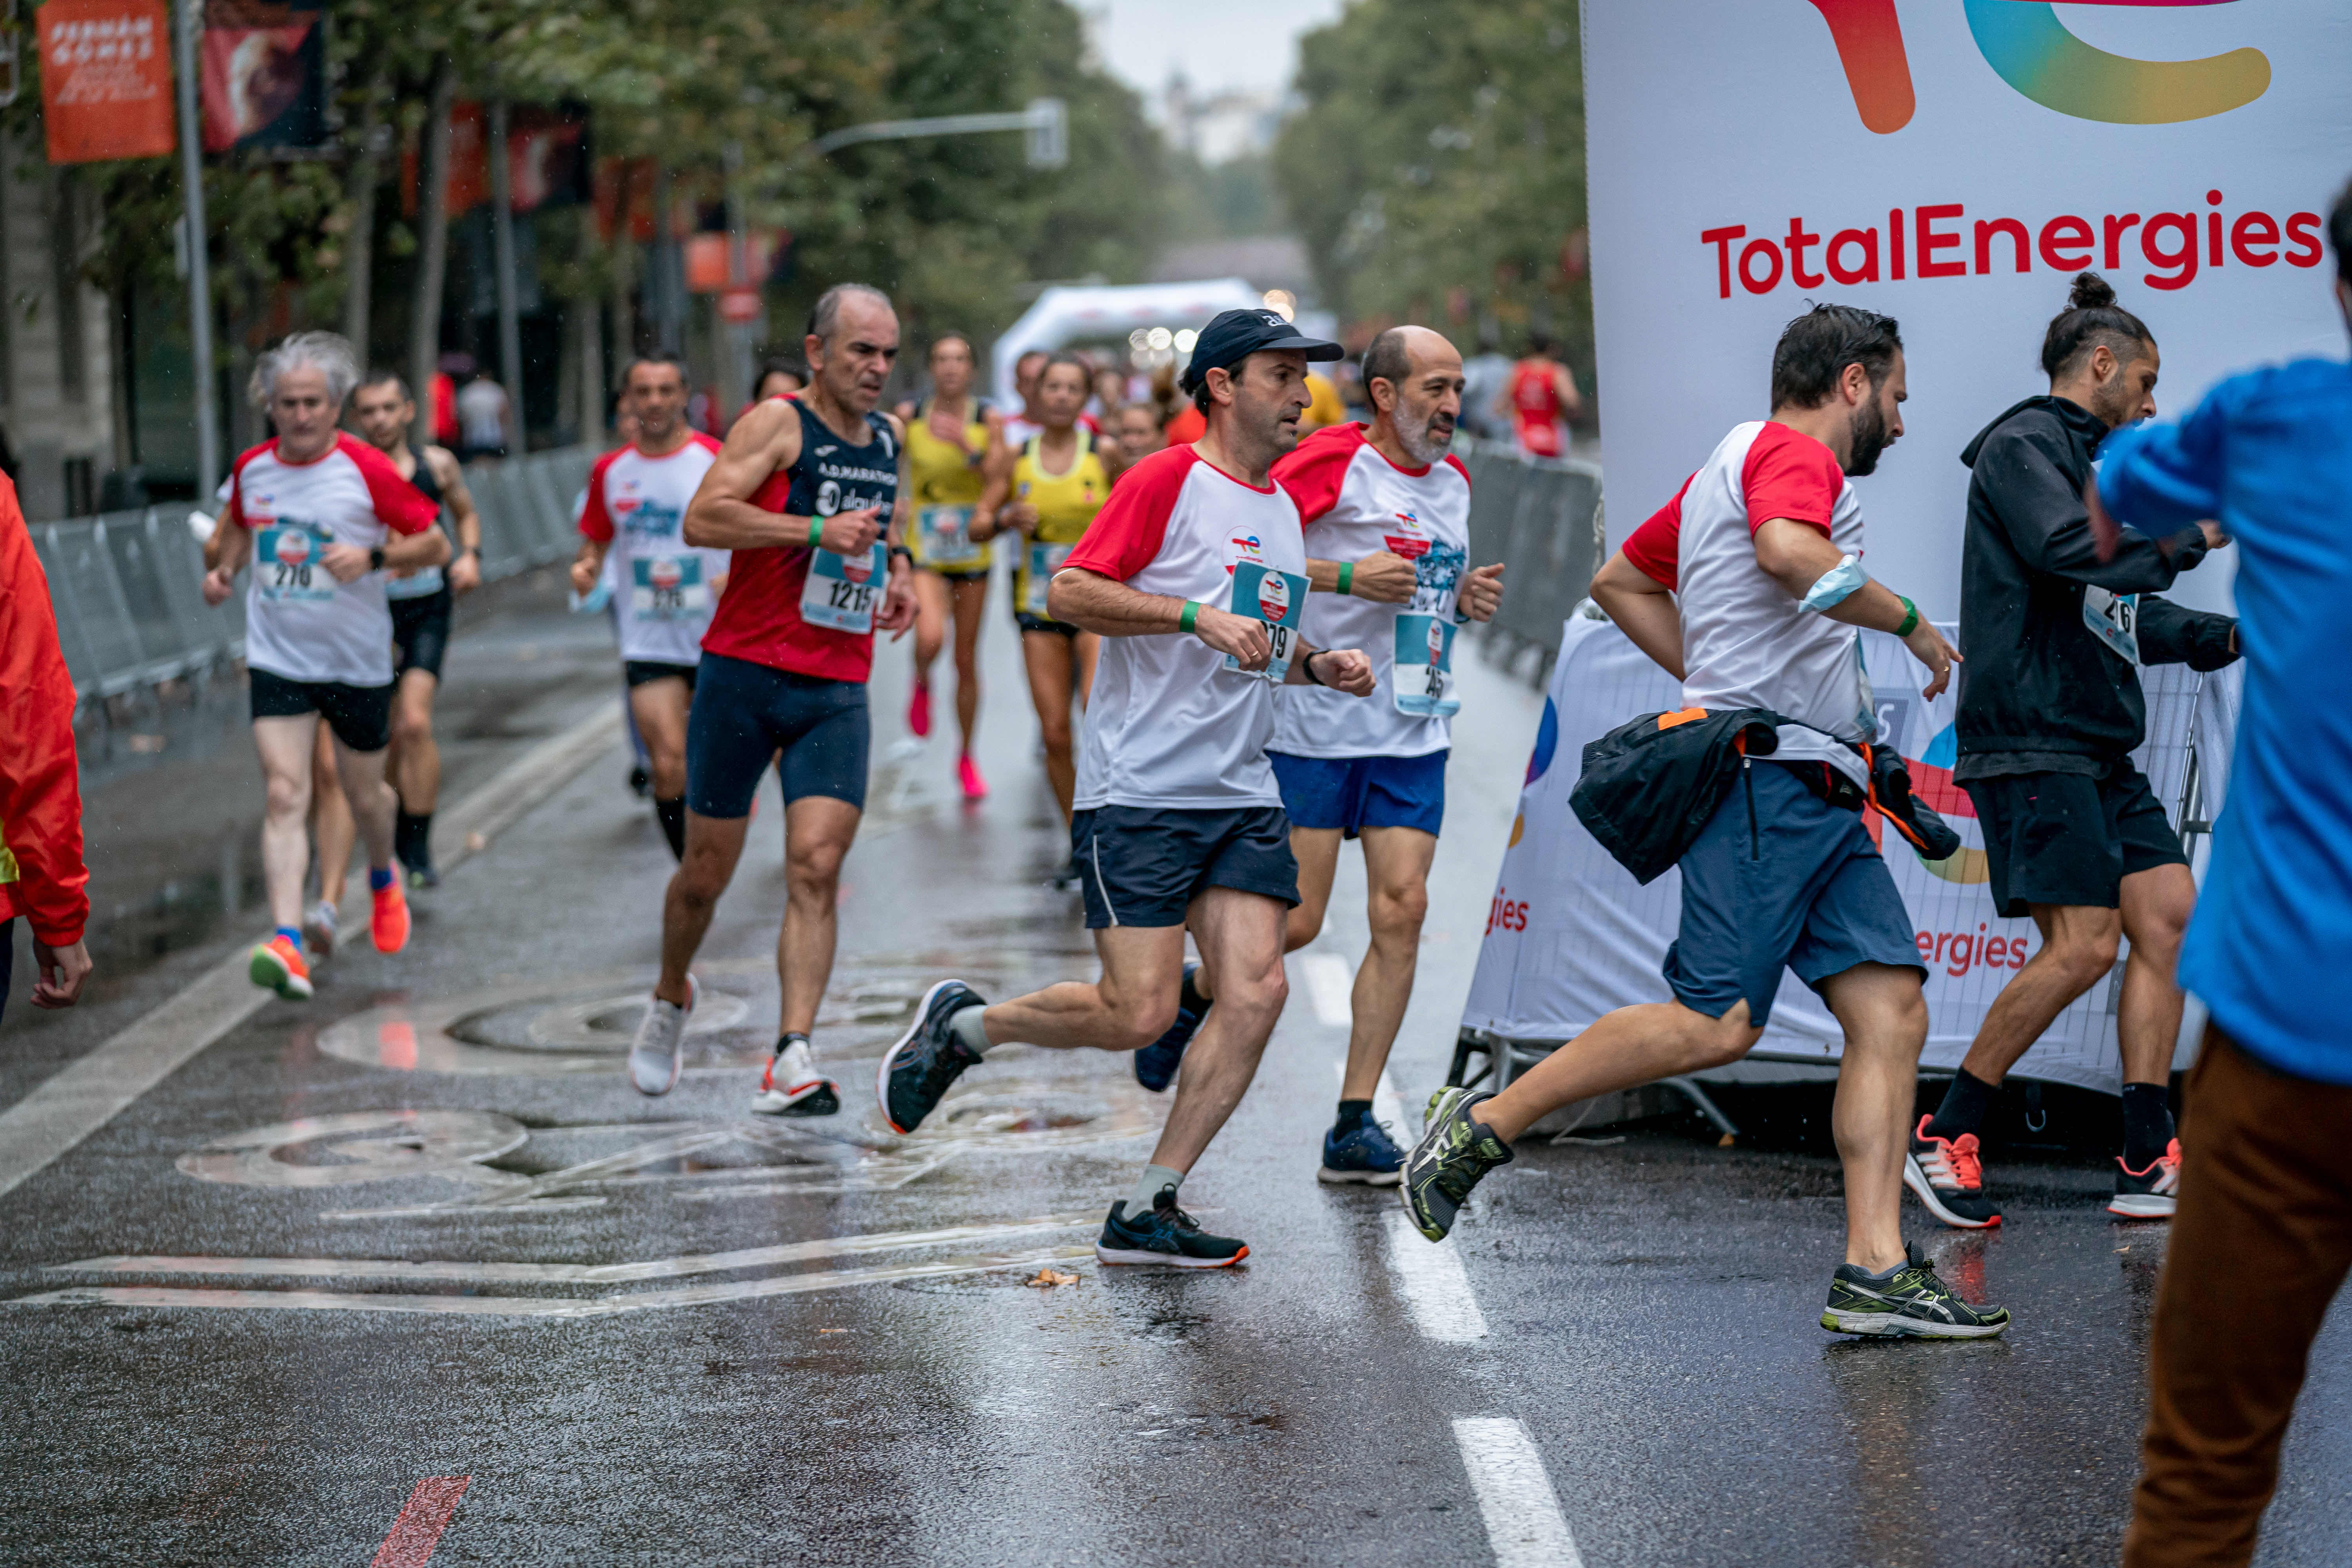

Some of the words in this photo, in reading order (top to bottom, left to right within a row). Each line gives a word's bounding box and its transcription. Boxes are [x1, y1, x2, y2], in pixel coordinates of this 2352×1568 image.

[1702, 190, 2322, 299] TotalEnergies
[829, 581, 873, 614] 1215
[1260, 620, 1287, 659] 79
